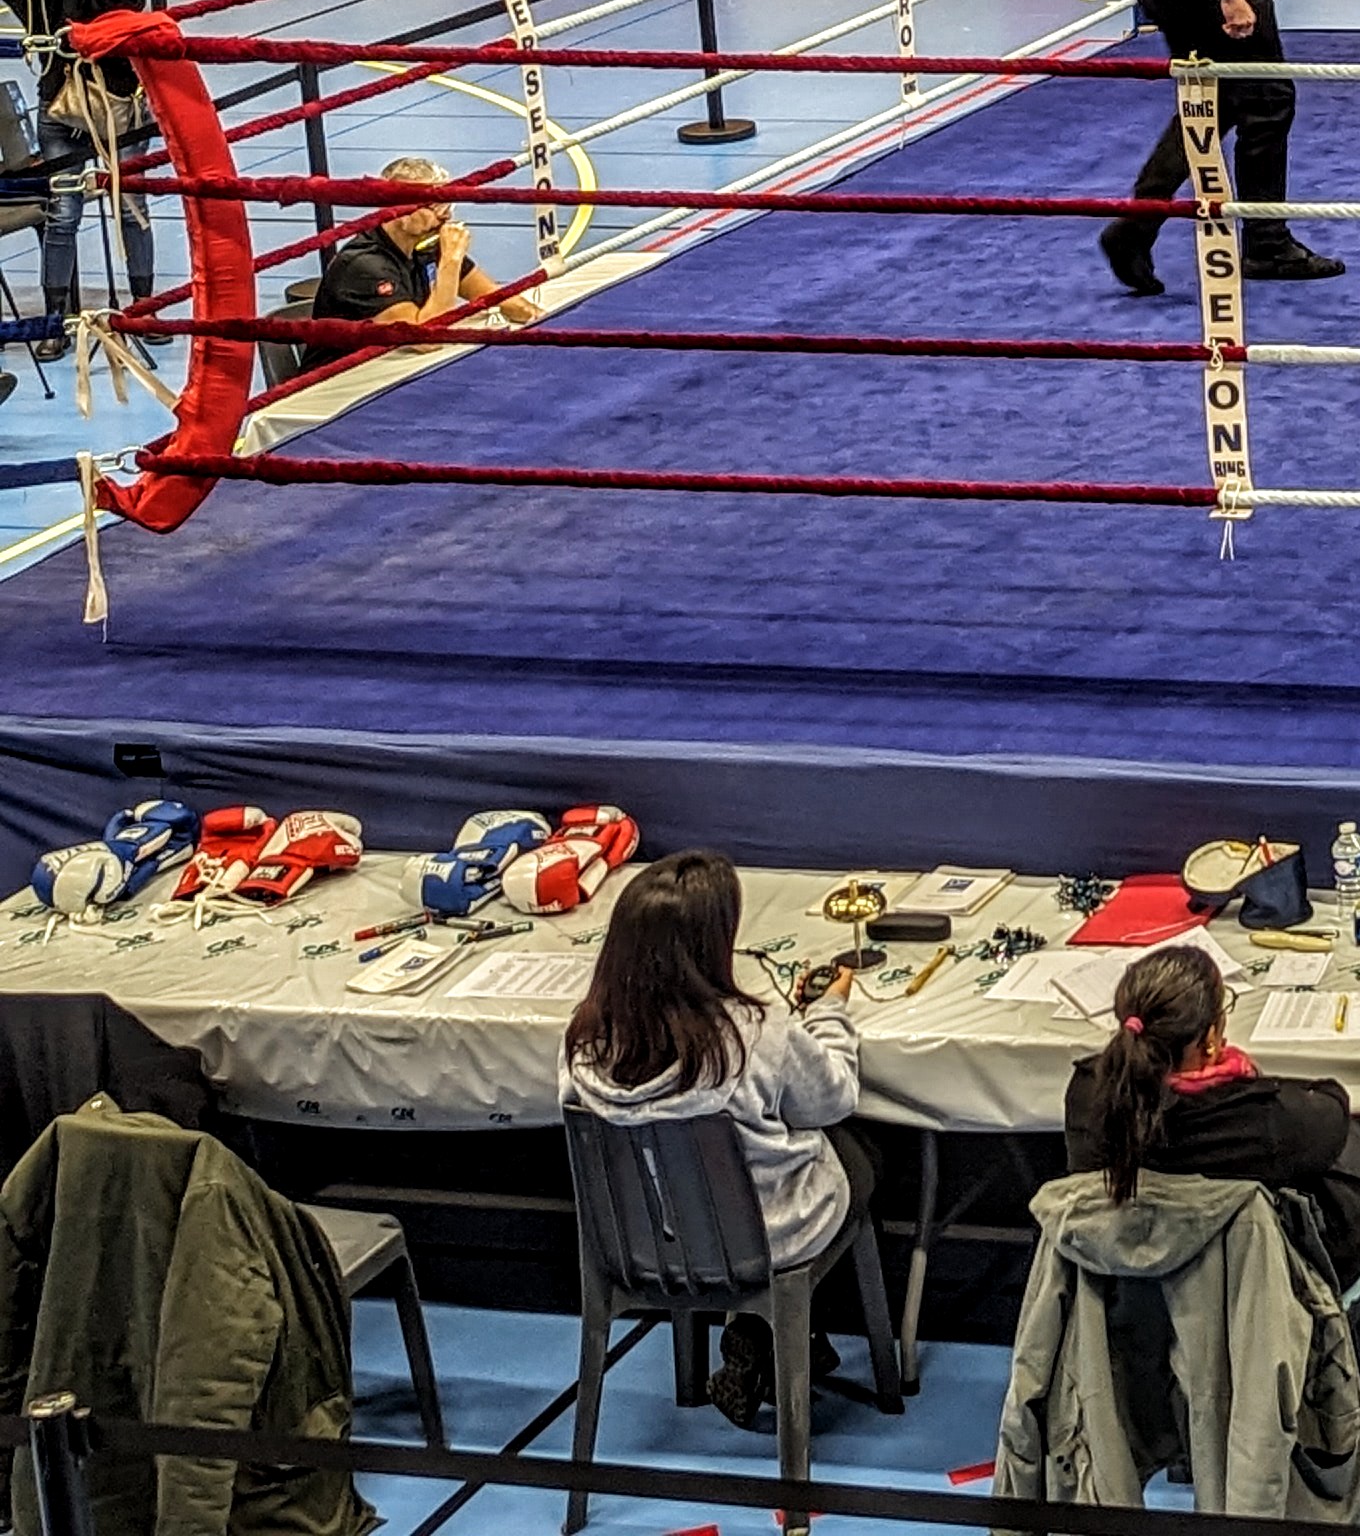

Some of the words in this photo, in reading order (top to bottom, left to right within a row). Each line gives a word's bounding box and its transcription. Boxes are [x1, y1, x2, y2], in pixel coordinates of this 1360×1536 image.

[1182, 100, 1214, 119] RING
[1186, 126, 1242, 453] VESEON
[1214, 460, 1246, 477] RING
